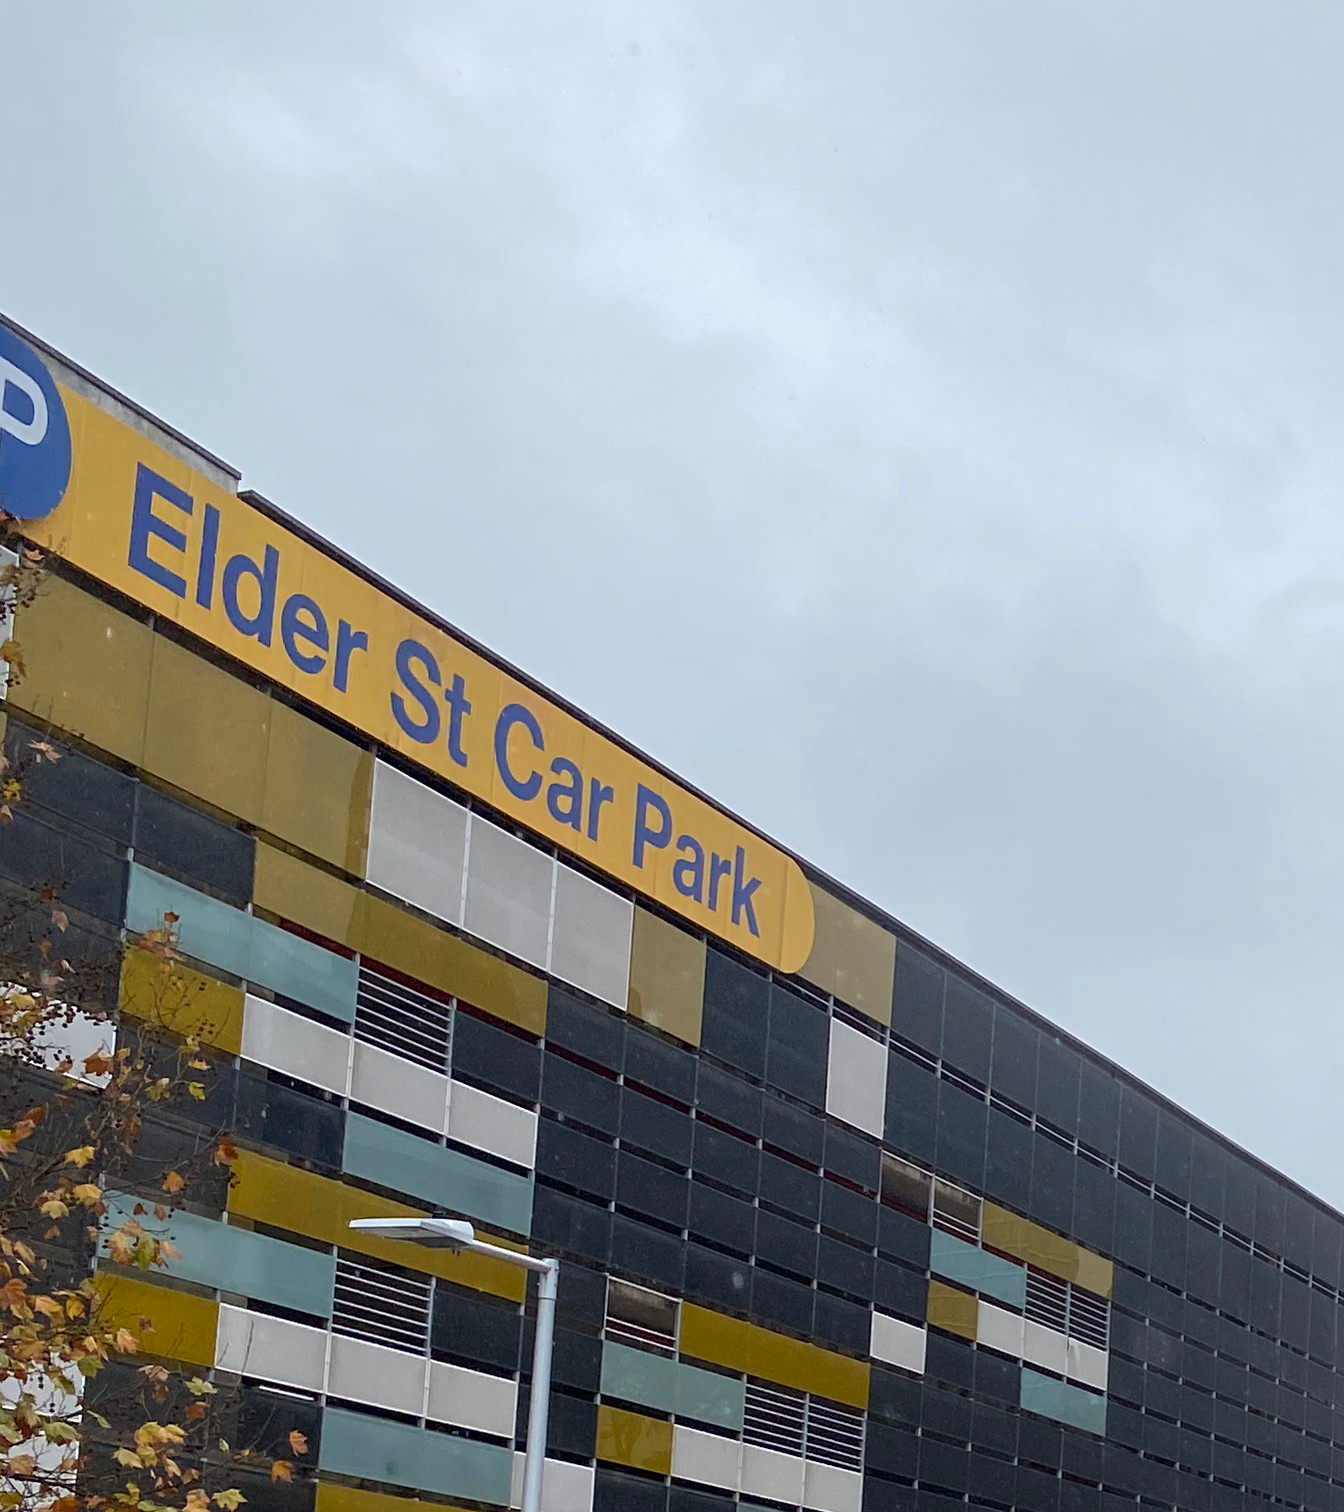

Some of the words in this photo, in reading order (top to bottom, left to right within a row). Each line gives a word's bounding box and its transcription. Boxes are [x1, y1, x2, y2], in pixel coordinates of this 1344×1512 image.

[127, 461, 369, 694] Elder
[391, 638, 471, 768] St
[493, 704, 614, 843] Car
[633, 783, 763, 936] Park
